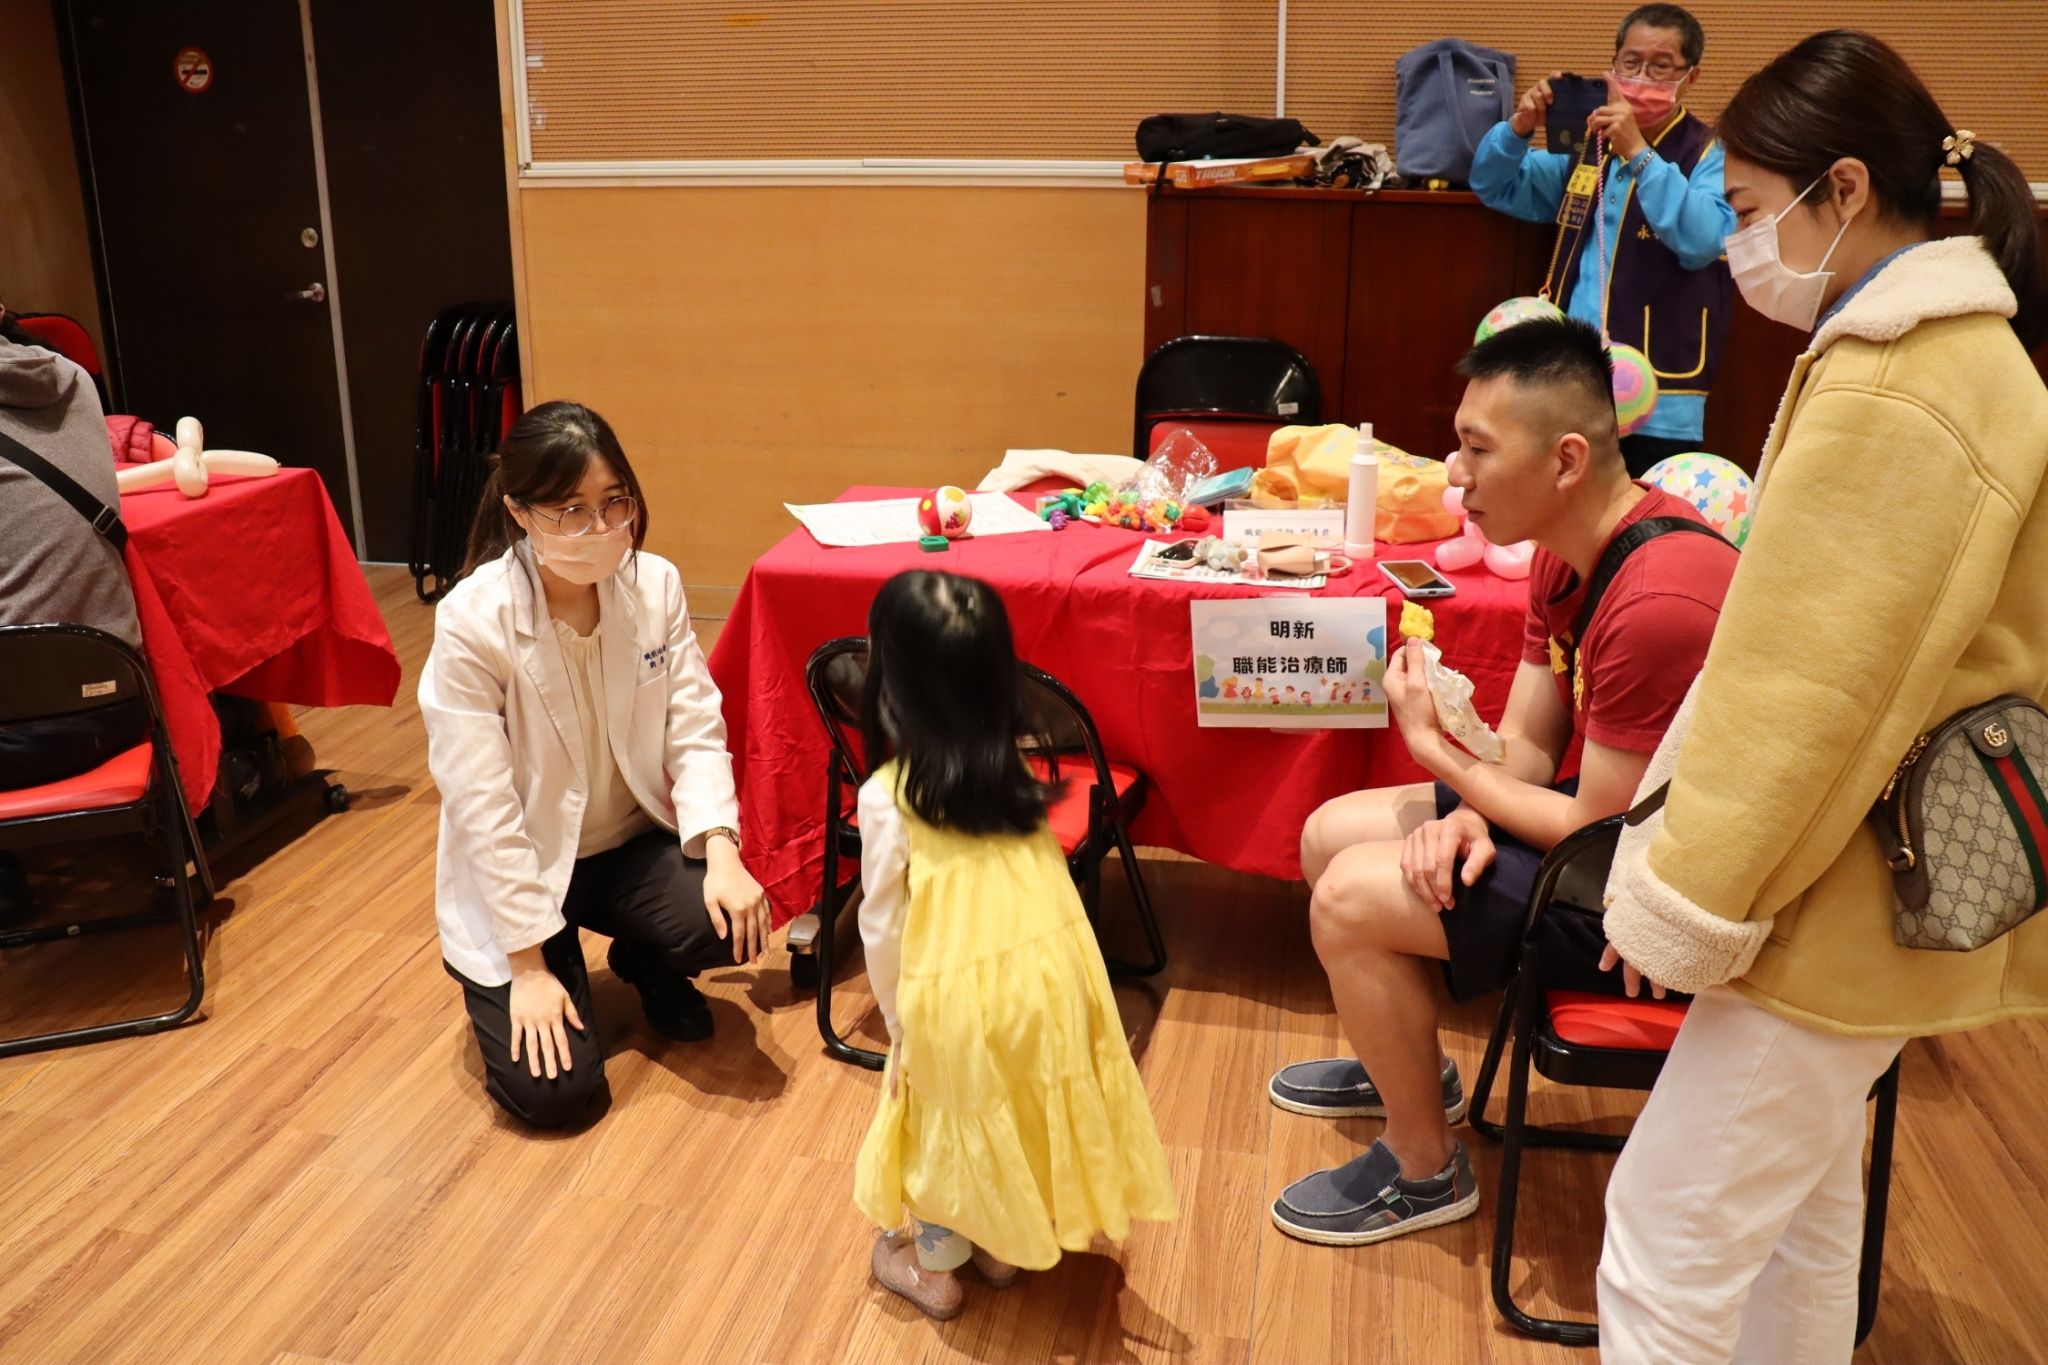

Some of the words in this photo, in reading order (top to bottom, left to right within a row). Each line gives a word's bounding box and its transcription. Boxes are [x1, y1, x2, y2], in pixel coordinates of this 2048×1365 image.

[1195, 166, 1237, 181] TRUCK
[1269, 620, 1315, 640] 明新
[1232, 655, 1348, 675] 職能治療師
